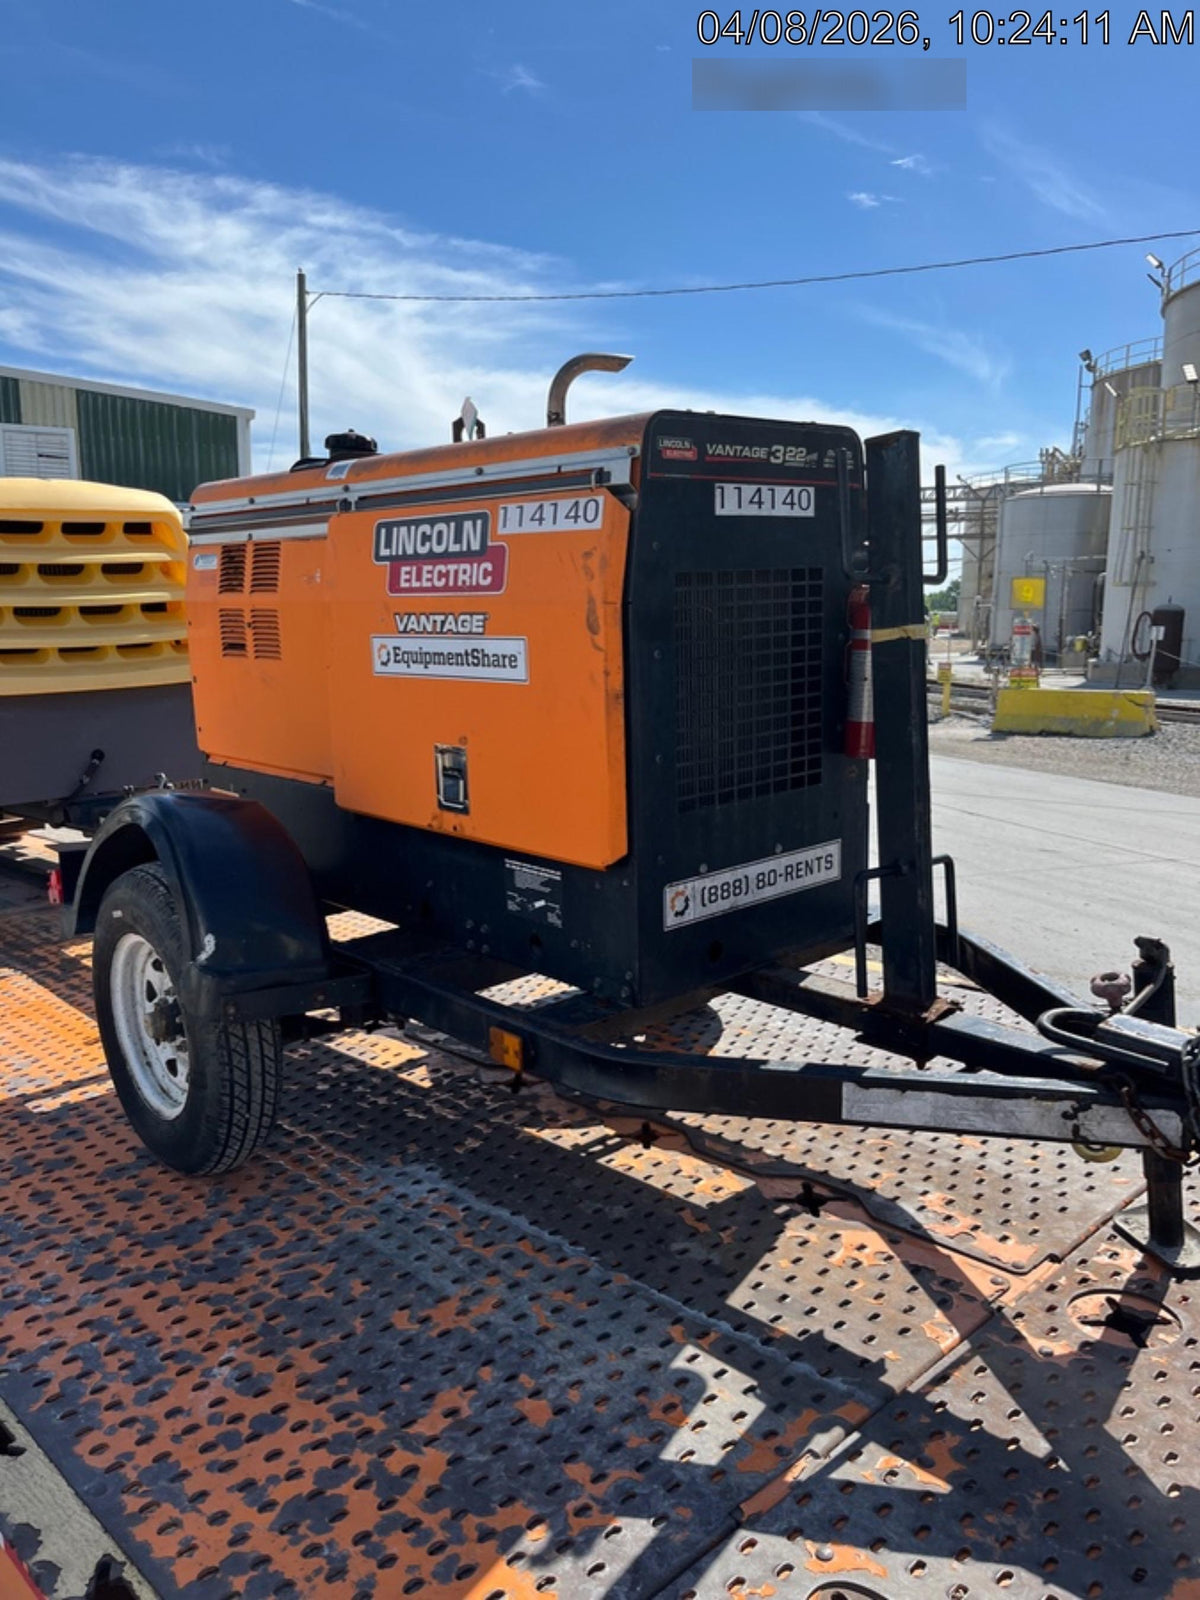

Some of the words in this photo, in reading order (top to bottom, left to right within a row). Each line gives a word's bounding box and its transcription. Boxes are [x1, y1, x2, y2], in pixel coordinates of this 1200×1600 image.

[706, 443, 769, 458] VANTAGE
[770, 445, 807, 464] 322
[716, 486, 811, 511] 114140
[500, 498, 600, 529] 114140
[378, 519, 483, 557] LINCOLN
[399, 562, 493, 588] ELECTRIC
[394, 613, 485, 634] VANTAGE
[392, 646, 518, 669] EquipmentShare
[701, 875, 750, 908] (888)
